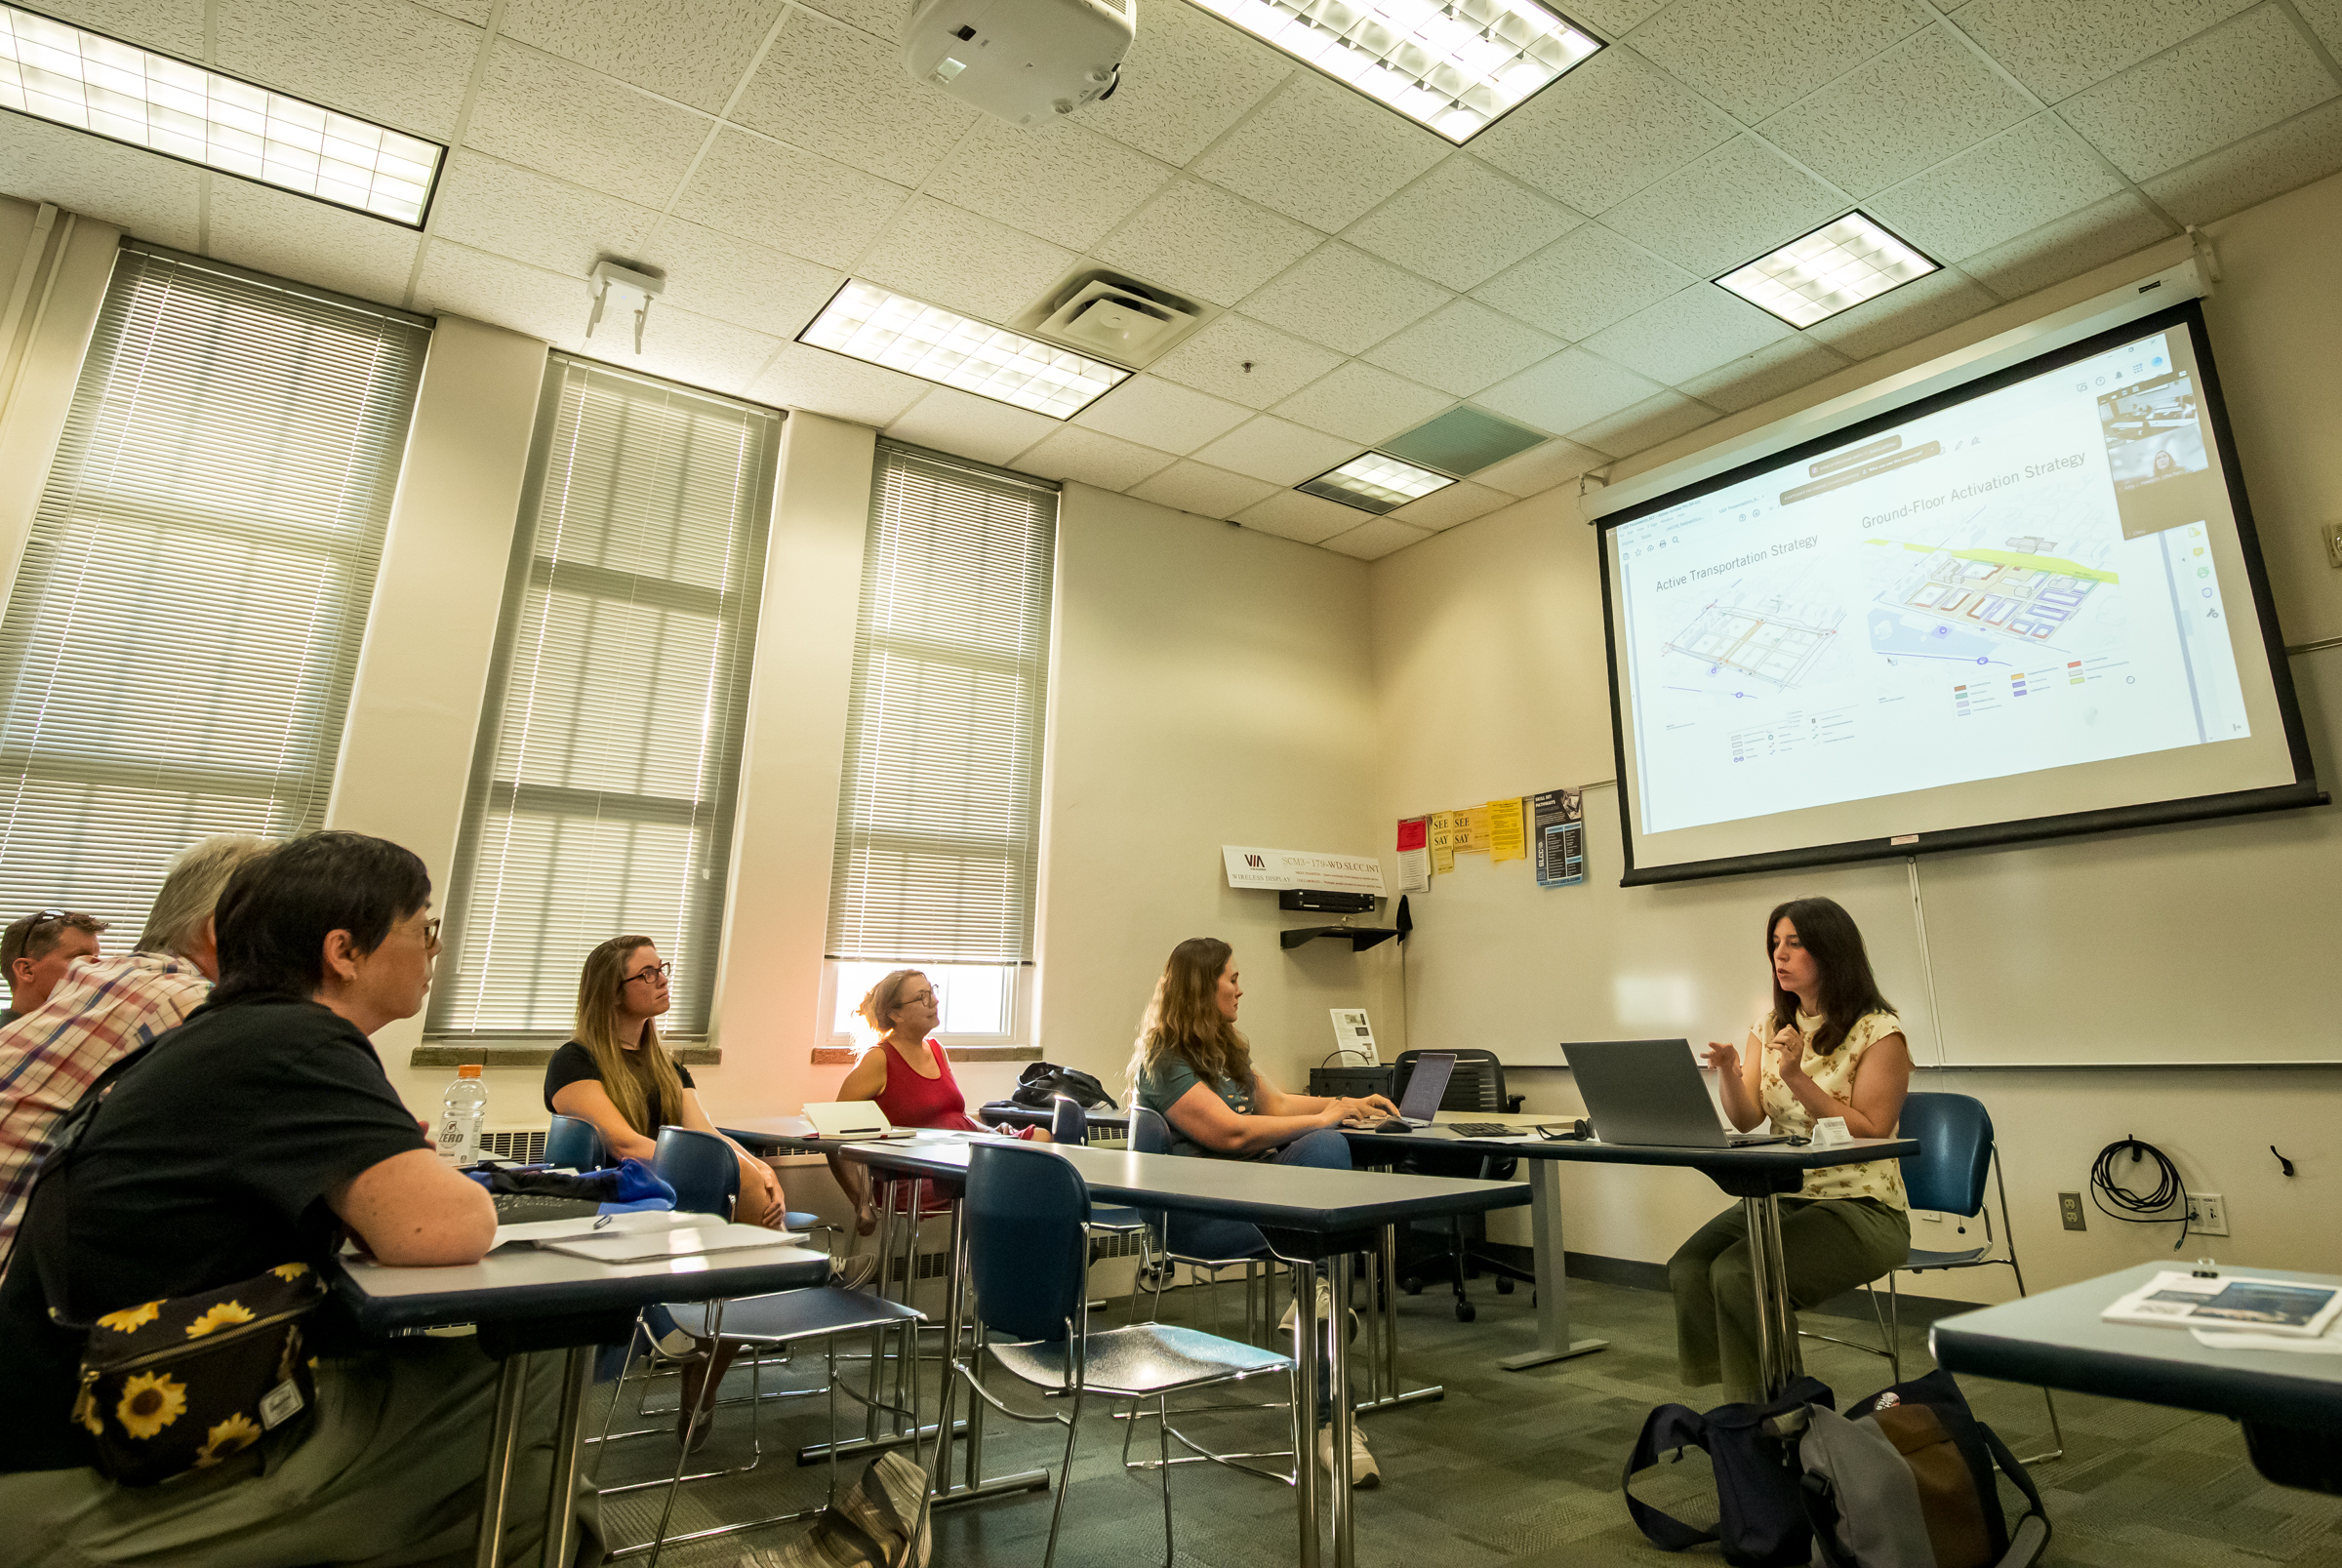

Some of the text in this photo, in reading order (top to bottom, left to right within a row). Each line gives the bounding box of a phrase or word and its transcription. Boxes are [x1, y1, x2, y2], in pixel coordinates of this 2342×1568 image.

[1862, 452, 2086, 529] Ground-Floor Activation Strategy
[1656, 535, 1818, 592] Active Transportation Strategy
[1433, 819, 1448, 829] SEE
[1454, 818, 1470, 827] SEE
[1434, 835, 1449, 846] SAY
[1454, 833, 1470, 844] SAY
[1244, 854, 1265, 867] VIA
[1265, 874, 1291, 883] DISPLAY
[438, 1133, 464, 1143] ZERO
